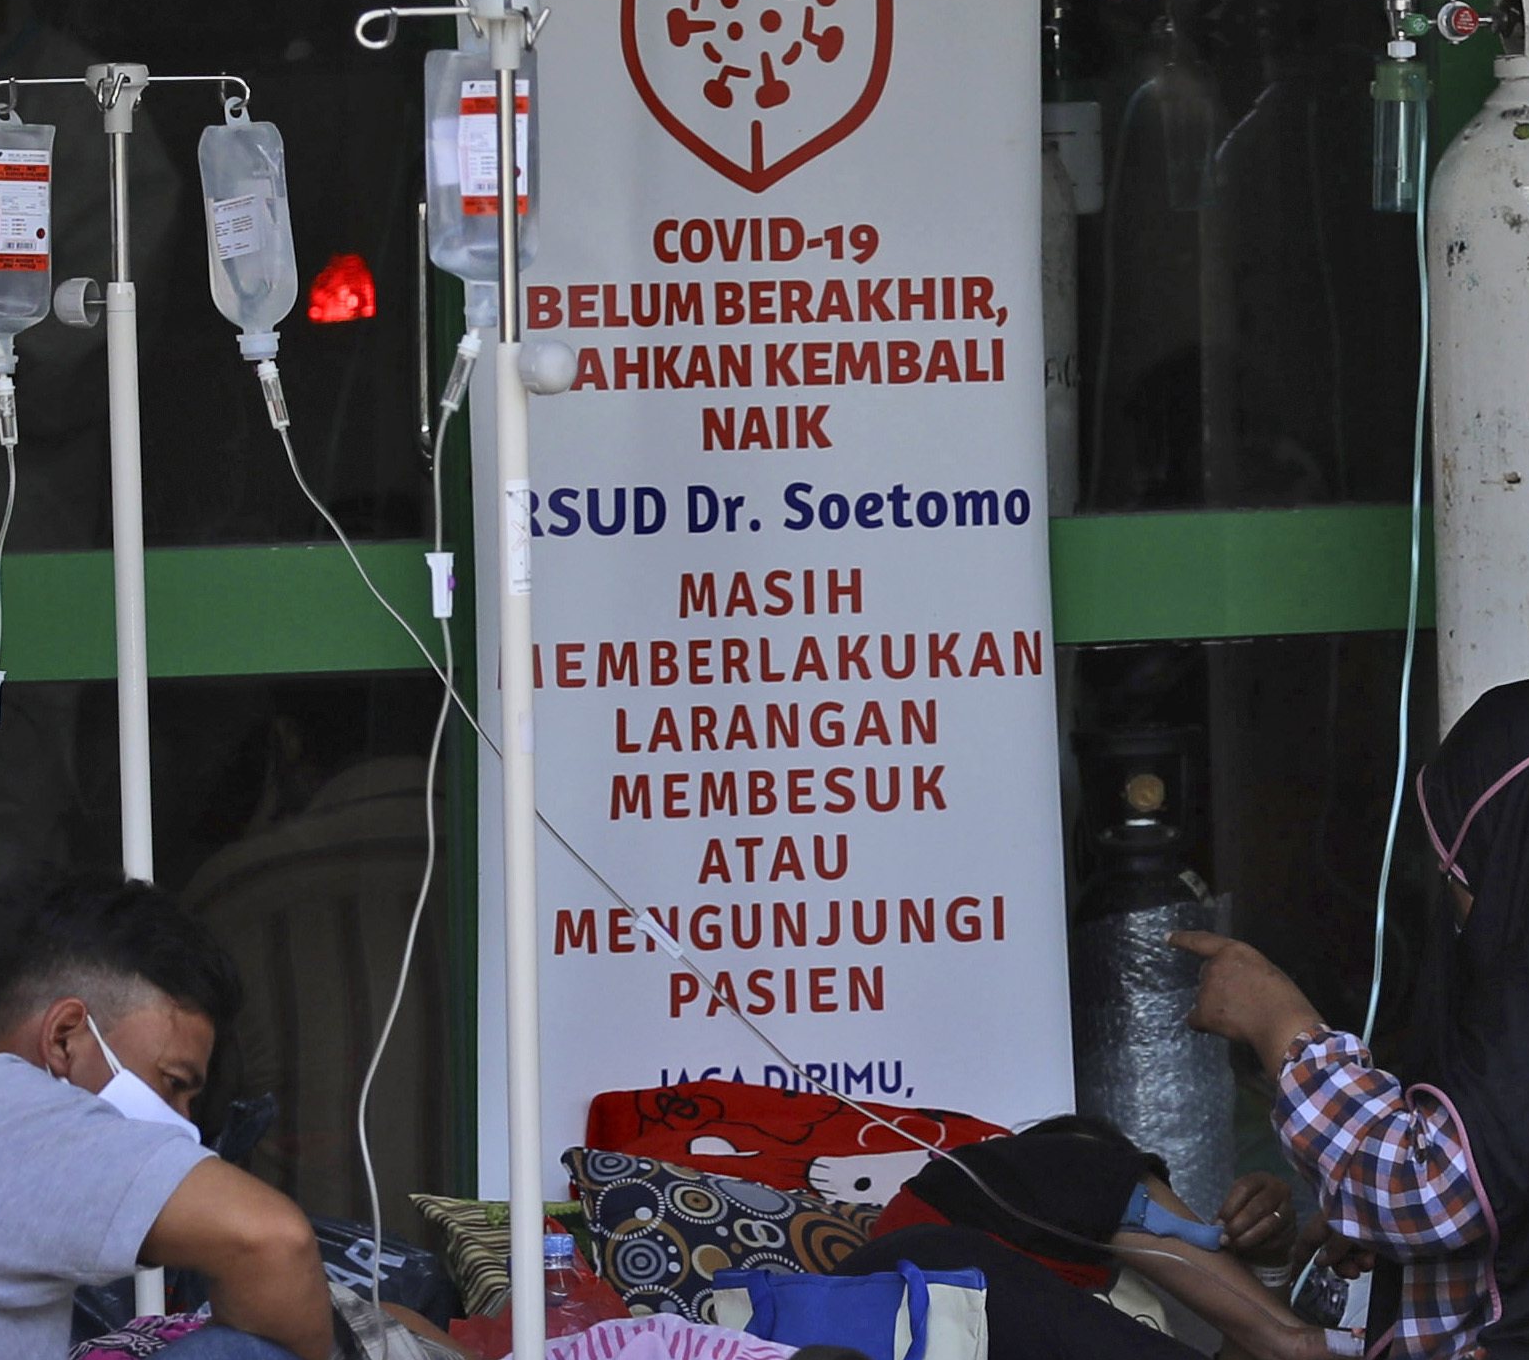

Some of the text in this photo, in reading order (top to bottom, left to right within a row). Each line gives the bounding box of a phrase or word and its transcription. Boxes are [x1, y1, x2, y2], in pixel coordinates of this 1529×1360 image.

[654, 218, 879, 264] COVID-19
[528, 276, 1008, 330] BELUM BERAKHIR,
[572, 343, 752, 390] AHKAN
[766, 338, 1004, 386] KEMBALI
[703, 405, 831, 450] NAIK
[686, 484, 761, 534] Dr.
[783, 482, 1031, 531] Soetomo
[680, 569, 862, 617] MASIH
[498, 632, 1042, 690] EMBERLAKUKAN
[617, 700, 936, 753] LARANGAN
[612, 766, 945, 818] MEMBESUK
[700, 836, 847, 883] ATAU
[555, 896, 1004, 955] MENGUNJUNGI
[671, 967, 883, 1017] PASIEN
[763, 1060, 914, 1099] DIRIMU,
